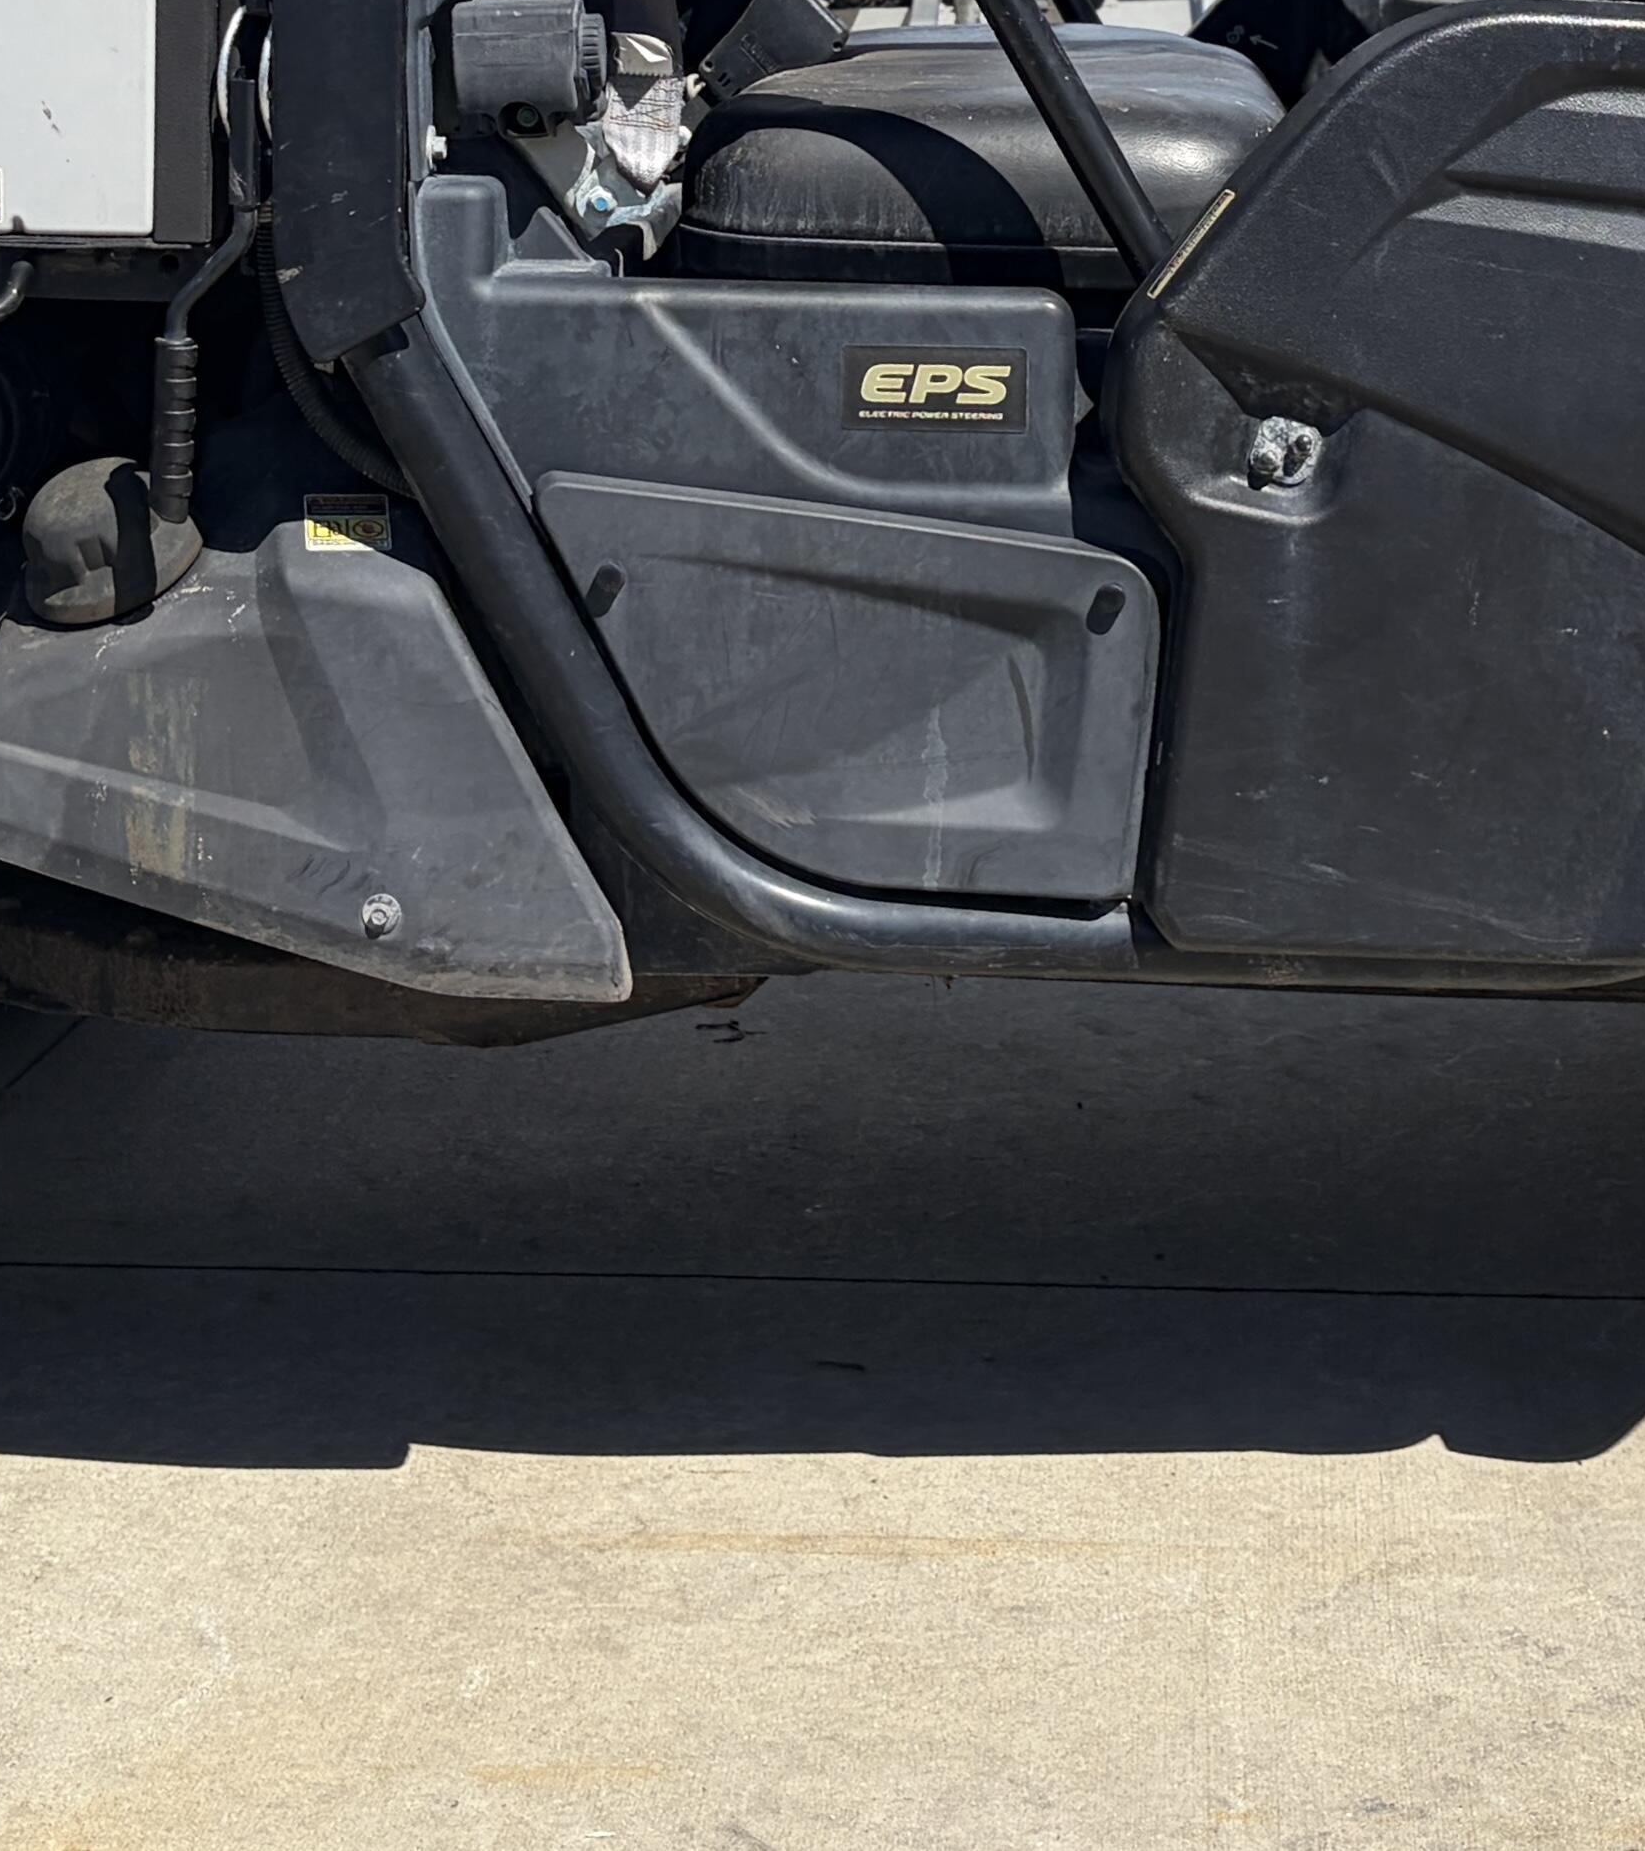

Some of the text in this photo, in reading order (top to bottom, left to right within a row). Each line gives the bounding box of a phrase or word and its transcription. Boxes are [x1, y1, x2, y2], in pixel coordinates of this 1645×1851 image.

[860, 363, 1012, 405] EPS
[858, 410, 1004, 421] ELECTRIC POWER STEERING
